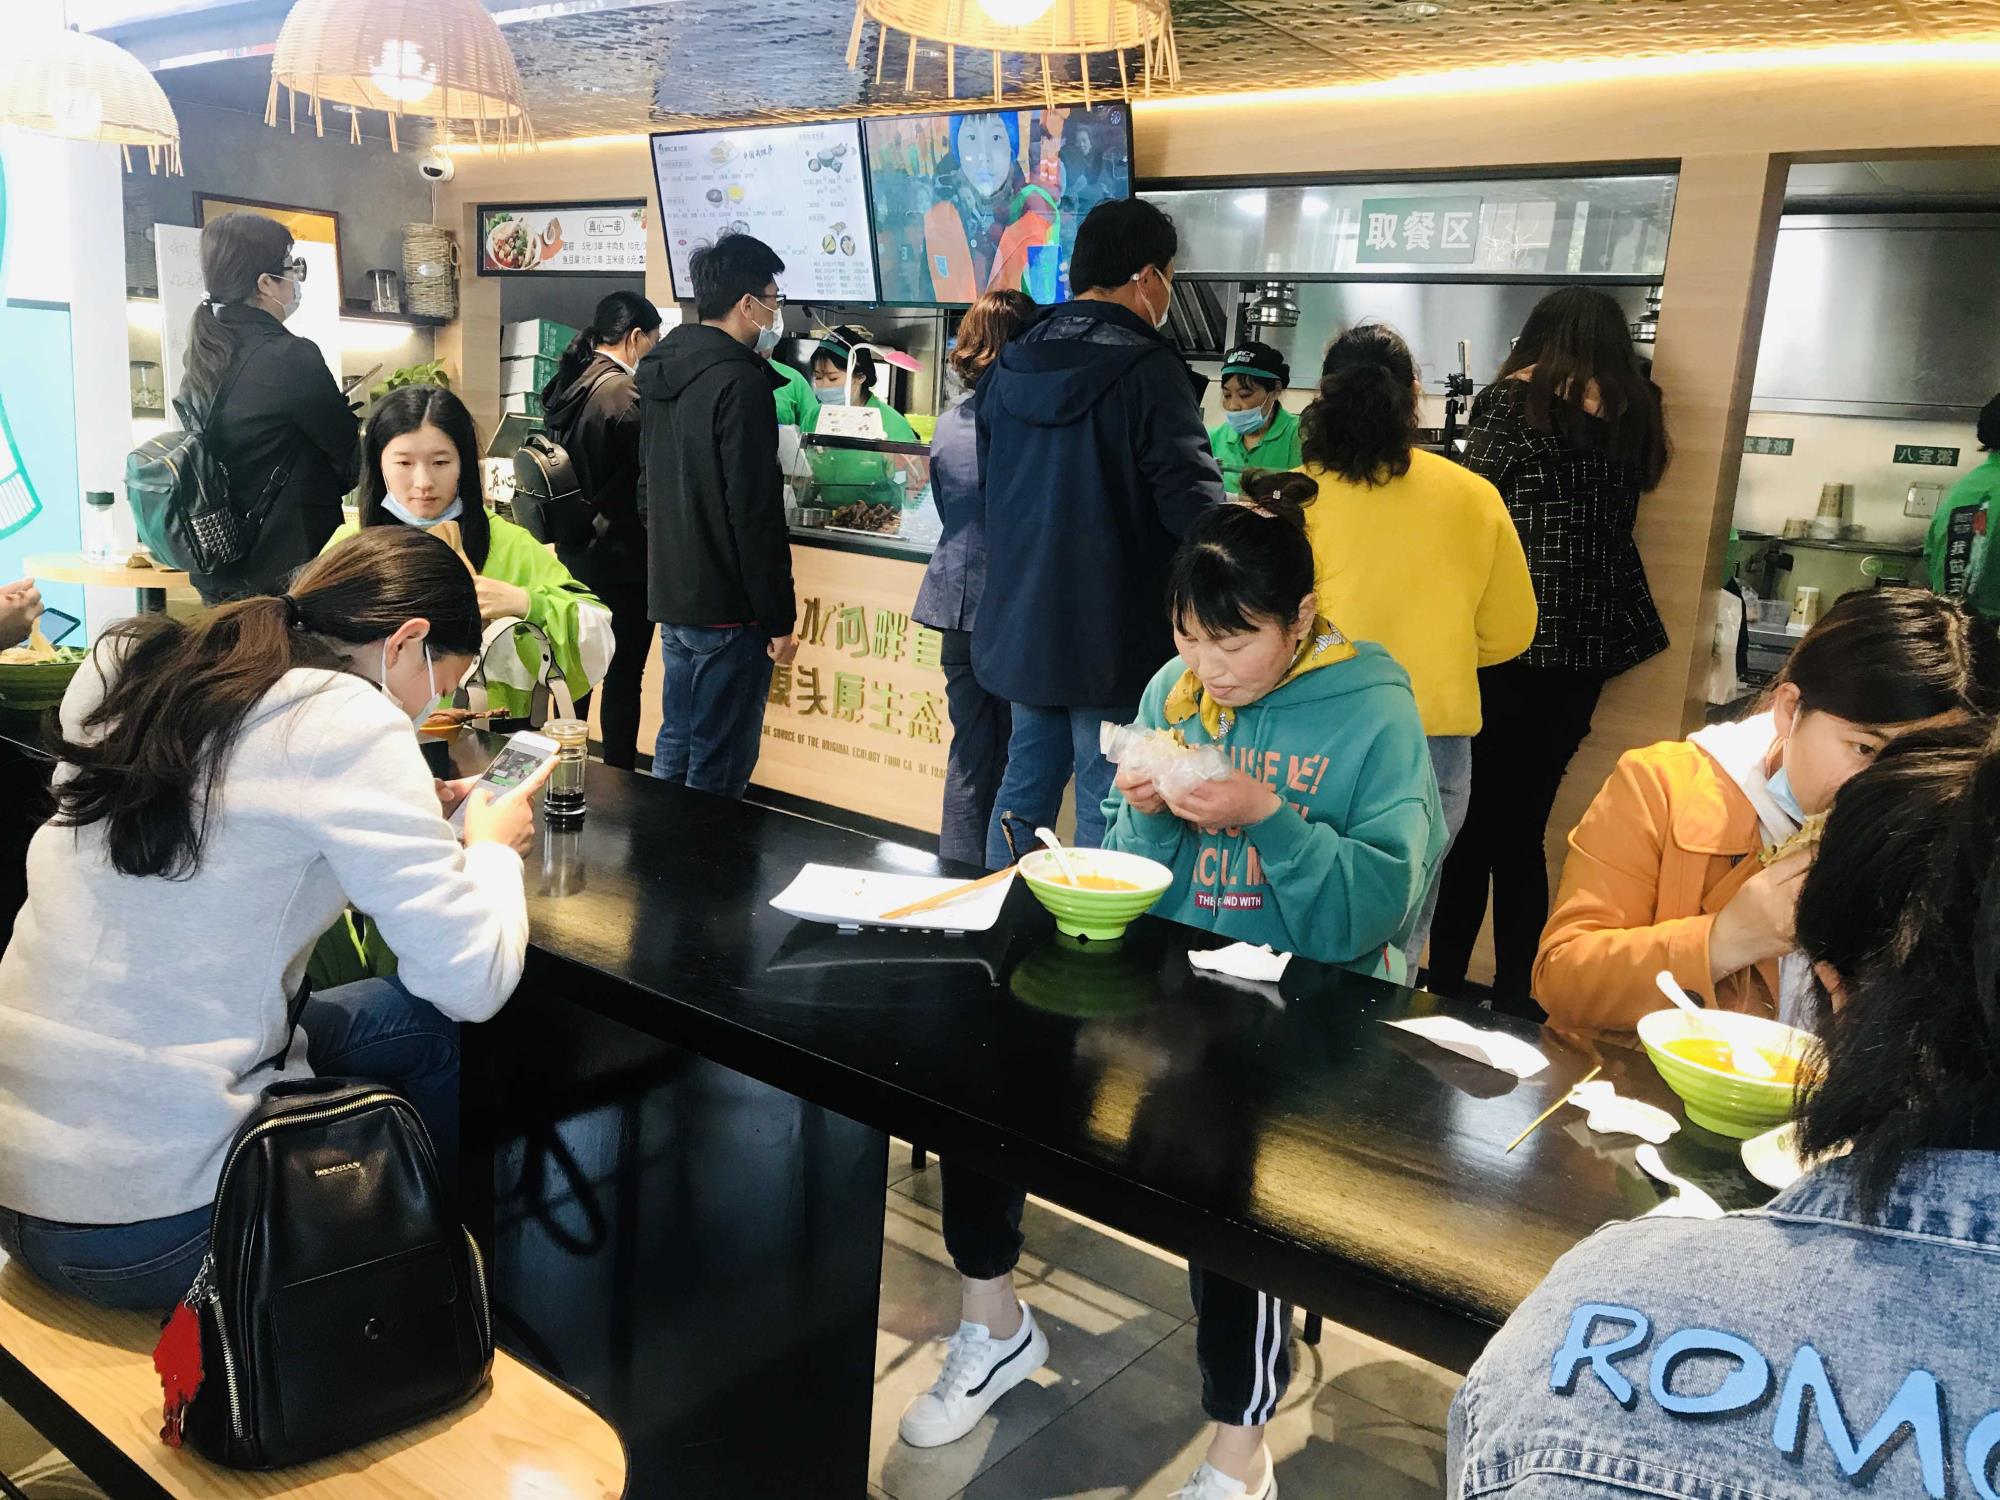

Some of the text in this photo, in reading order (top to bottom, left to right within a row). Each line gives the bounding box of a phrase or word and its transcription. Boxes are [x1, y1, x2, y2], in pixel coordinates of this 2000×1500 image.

[589, 219, 621, 234] 真心一串
[1365, 210, 1473, 251] 取餐区
[1898, 447, 1953, 465] 八宝粥
[773, 727, 796, 743] SOURCE
[797, 733, 805, 745] OF
[807, 735, 820, 749] THE
[821, 739, 850, 756] ORIGINAL
[852, 746, 881, 764] ECOLOGY
[1239, 896, 1262, 907] WITH
